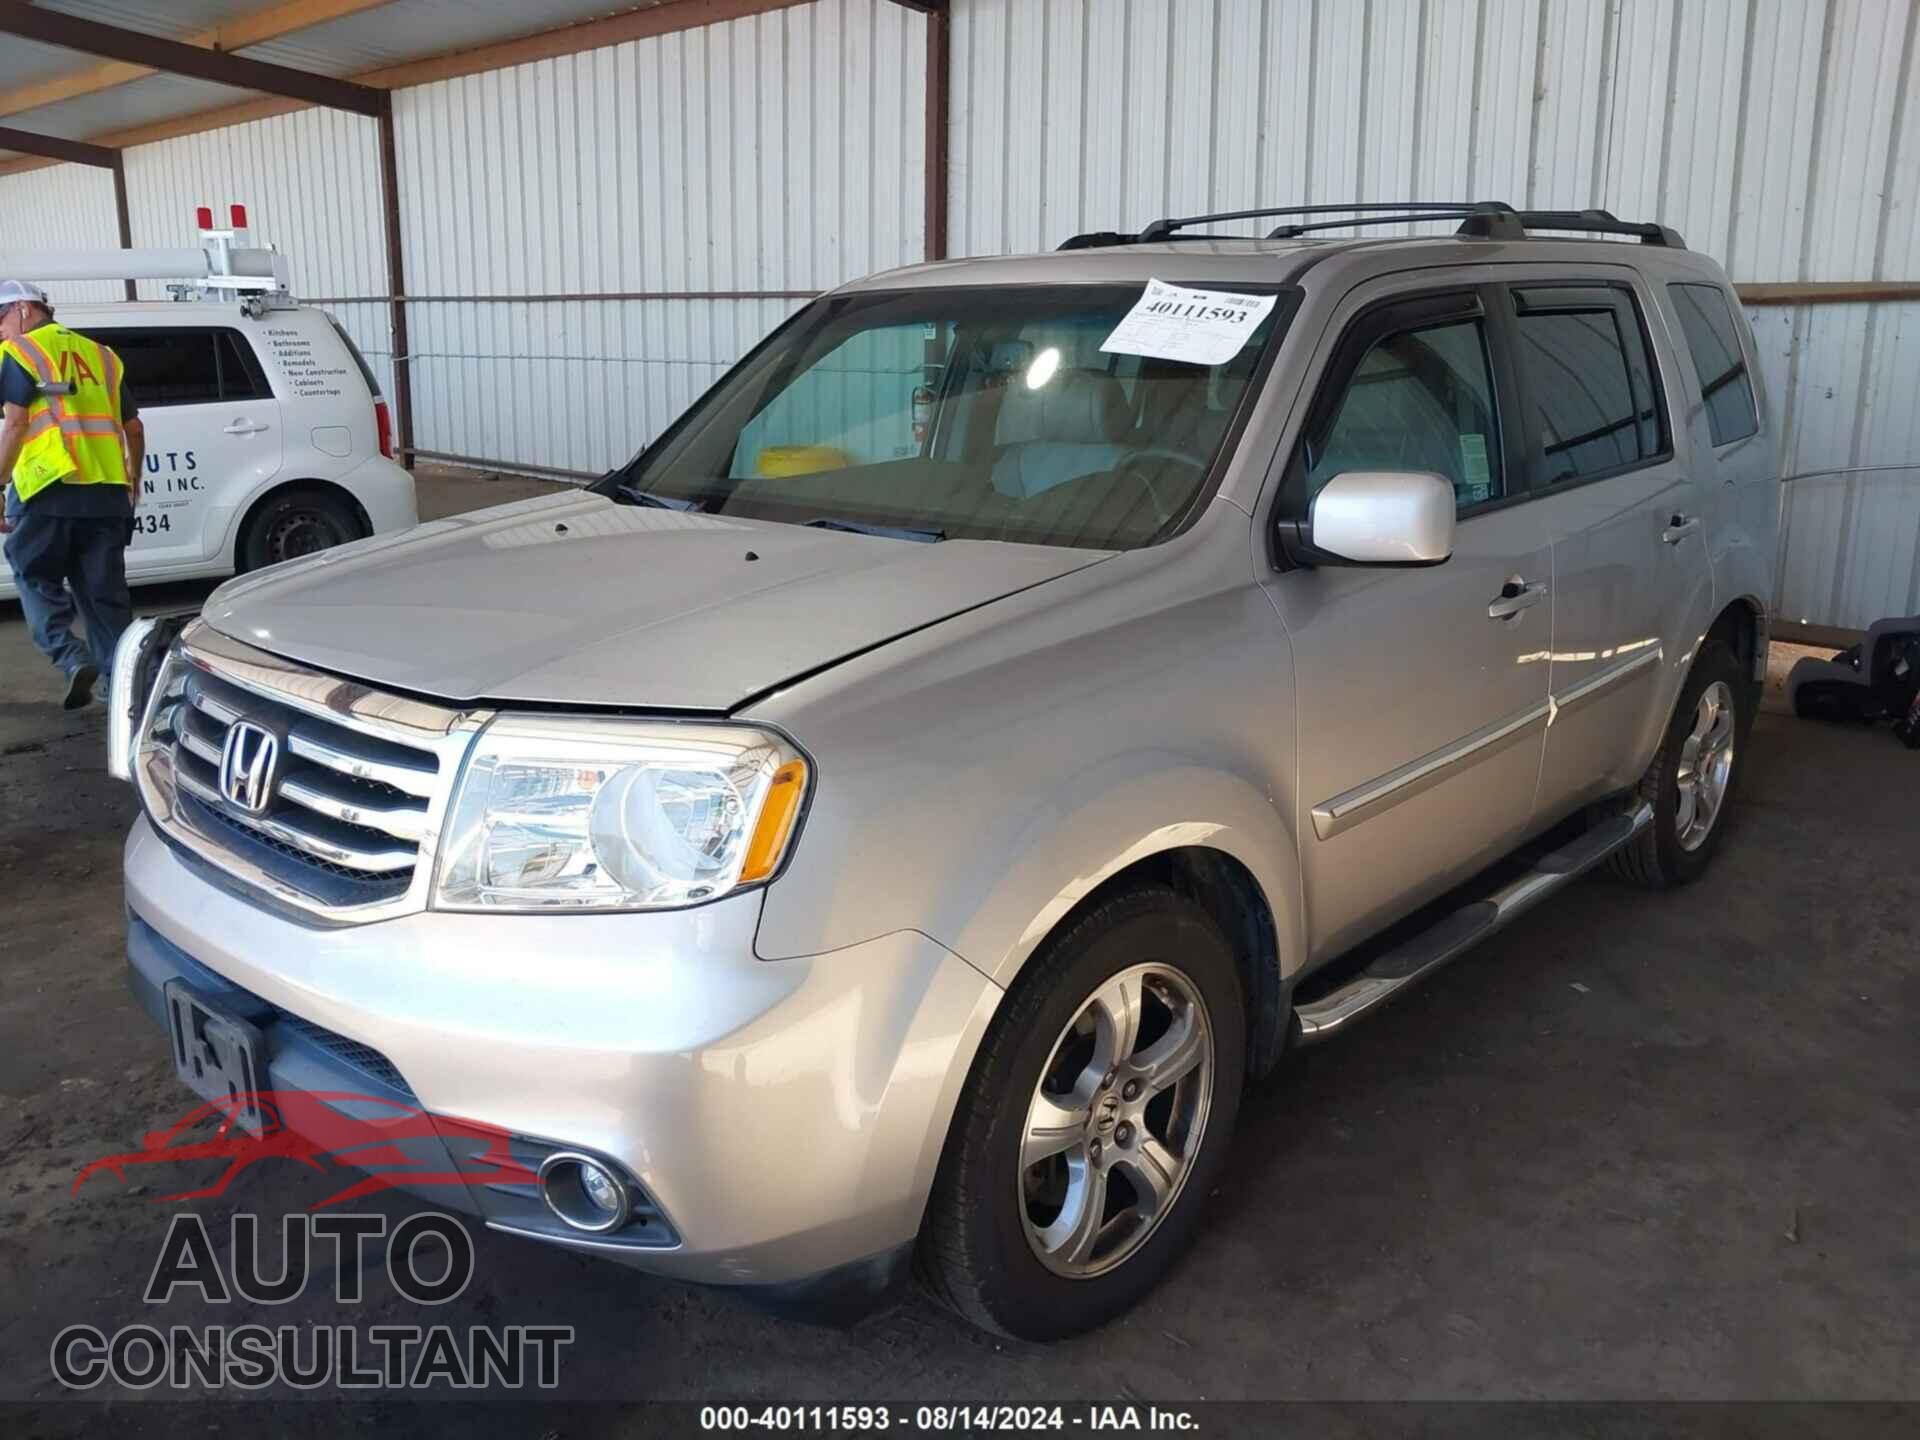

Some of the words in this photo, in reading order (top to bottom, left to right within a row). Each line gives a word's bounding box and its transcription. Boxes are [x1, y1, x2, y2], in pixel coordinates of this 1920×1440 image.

[1146, 301, 1247, 323] 40111593
[268, 329, 298, 337] Kitchens
[288, 369, 303, 377] New
[305, 369, 347, 377] Construction
[294, 379, 325, 387] Cabinets
[299, 389, 341, 397] Countertops
[145, 451, 197, 474] UTS
[143, 479, 155, 495] N
[167, 476, 206, 493] INC.
[133, 513, 171, 534] 434
